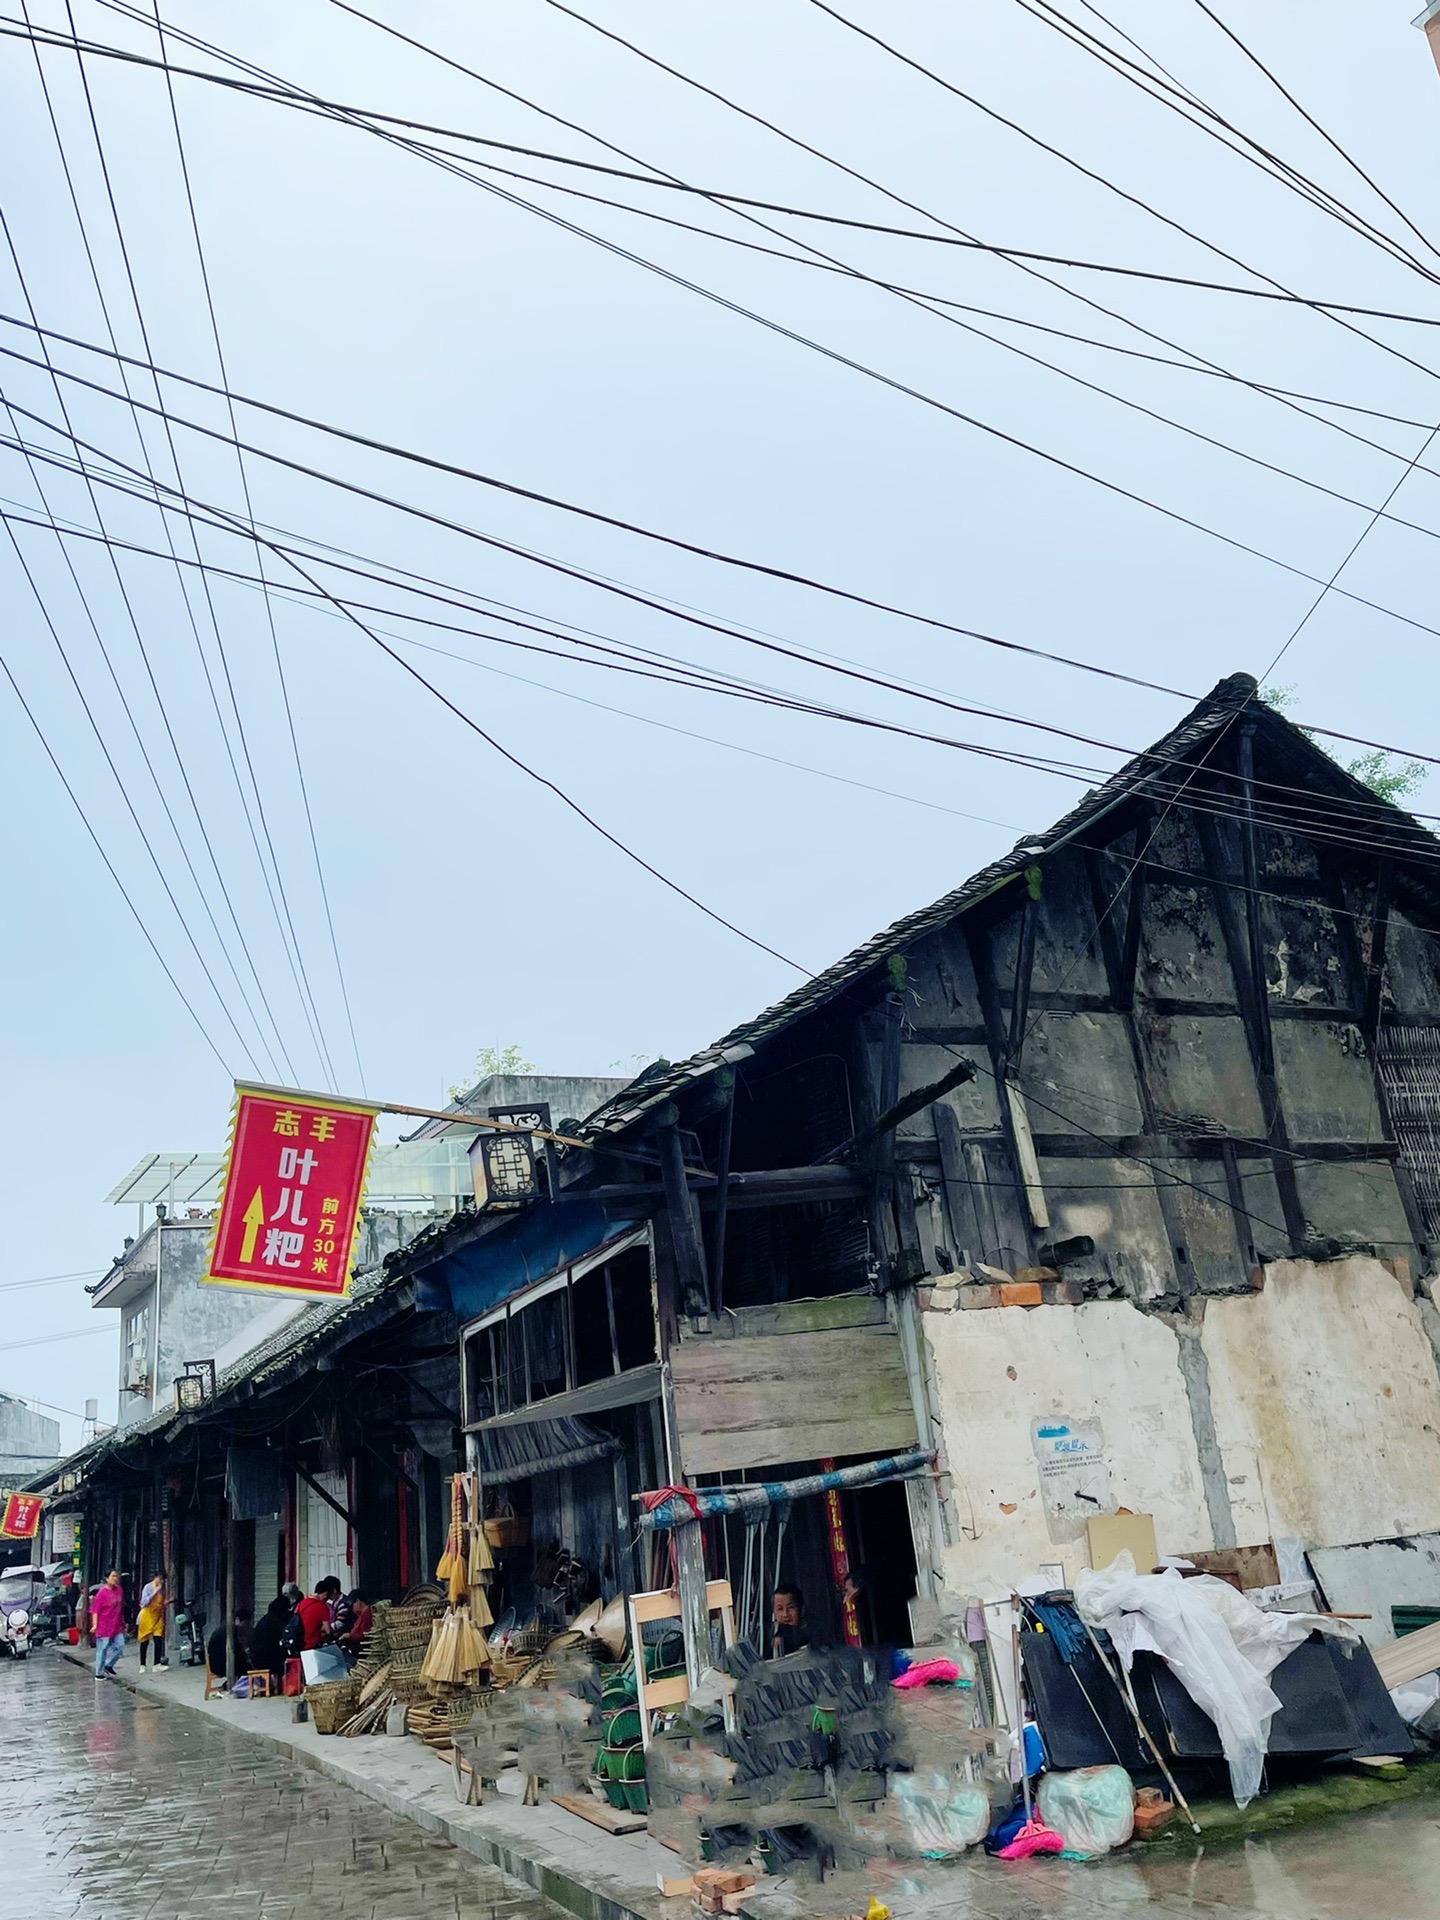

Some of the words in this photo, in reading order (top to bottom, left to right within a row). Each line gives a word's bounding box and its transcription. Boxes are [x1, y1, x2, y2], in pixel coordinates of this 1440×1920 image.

[272, 1110, 337, 1143] 志丰
[261, 1146, 319, 1269] 叶儿粑
[310, 1197, 340, 1274] 前方30米
